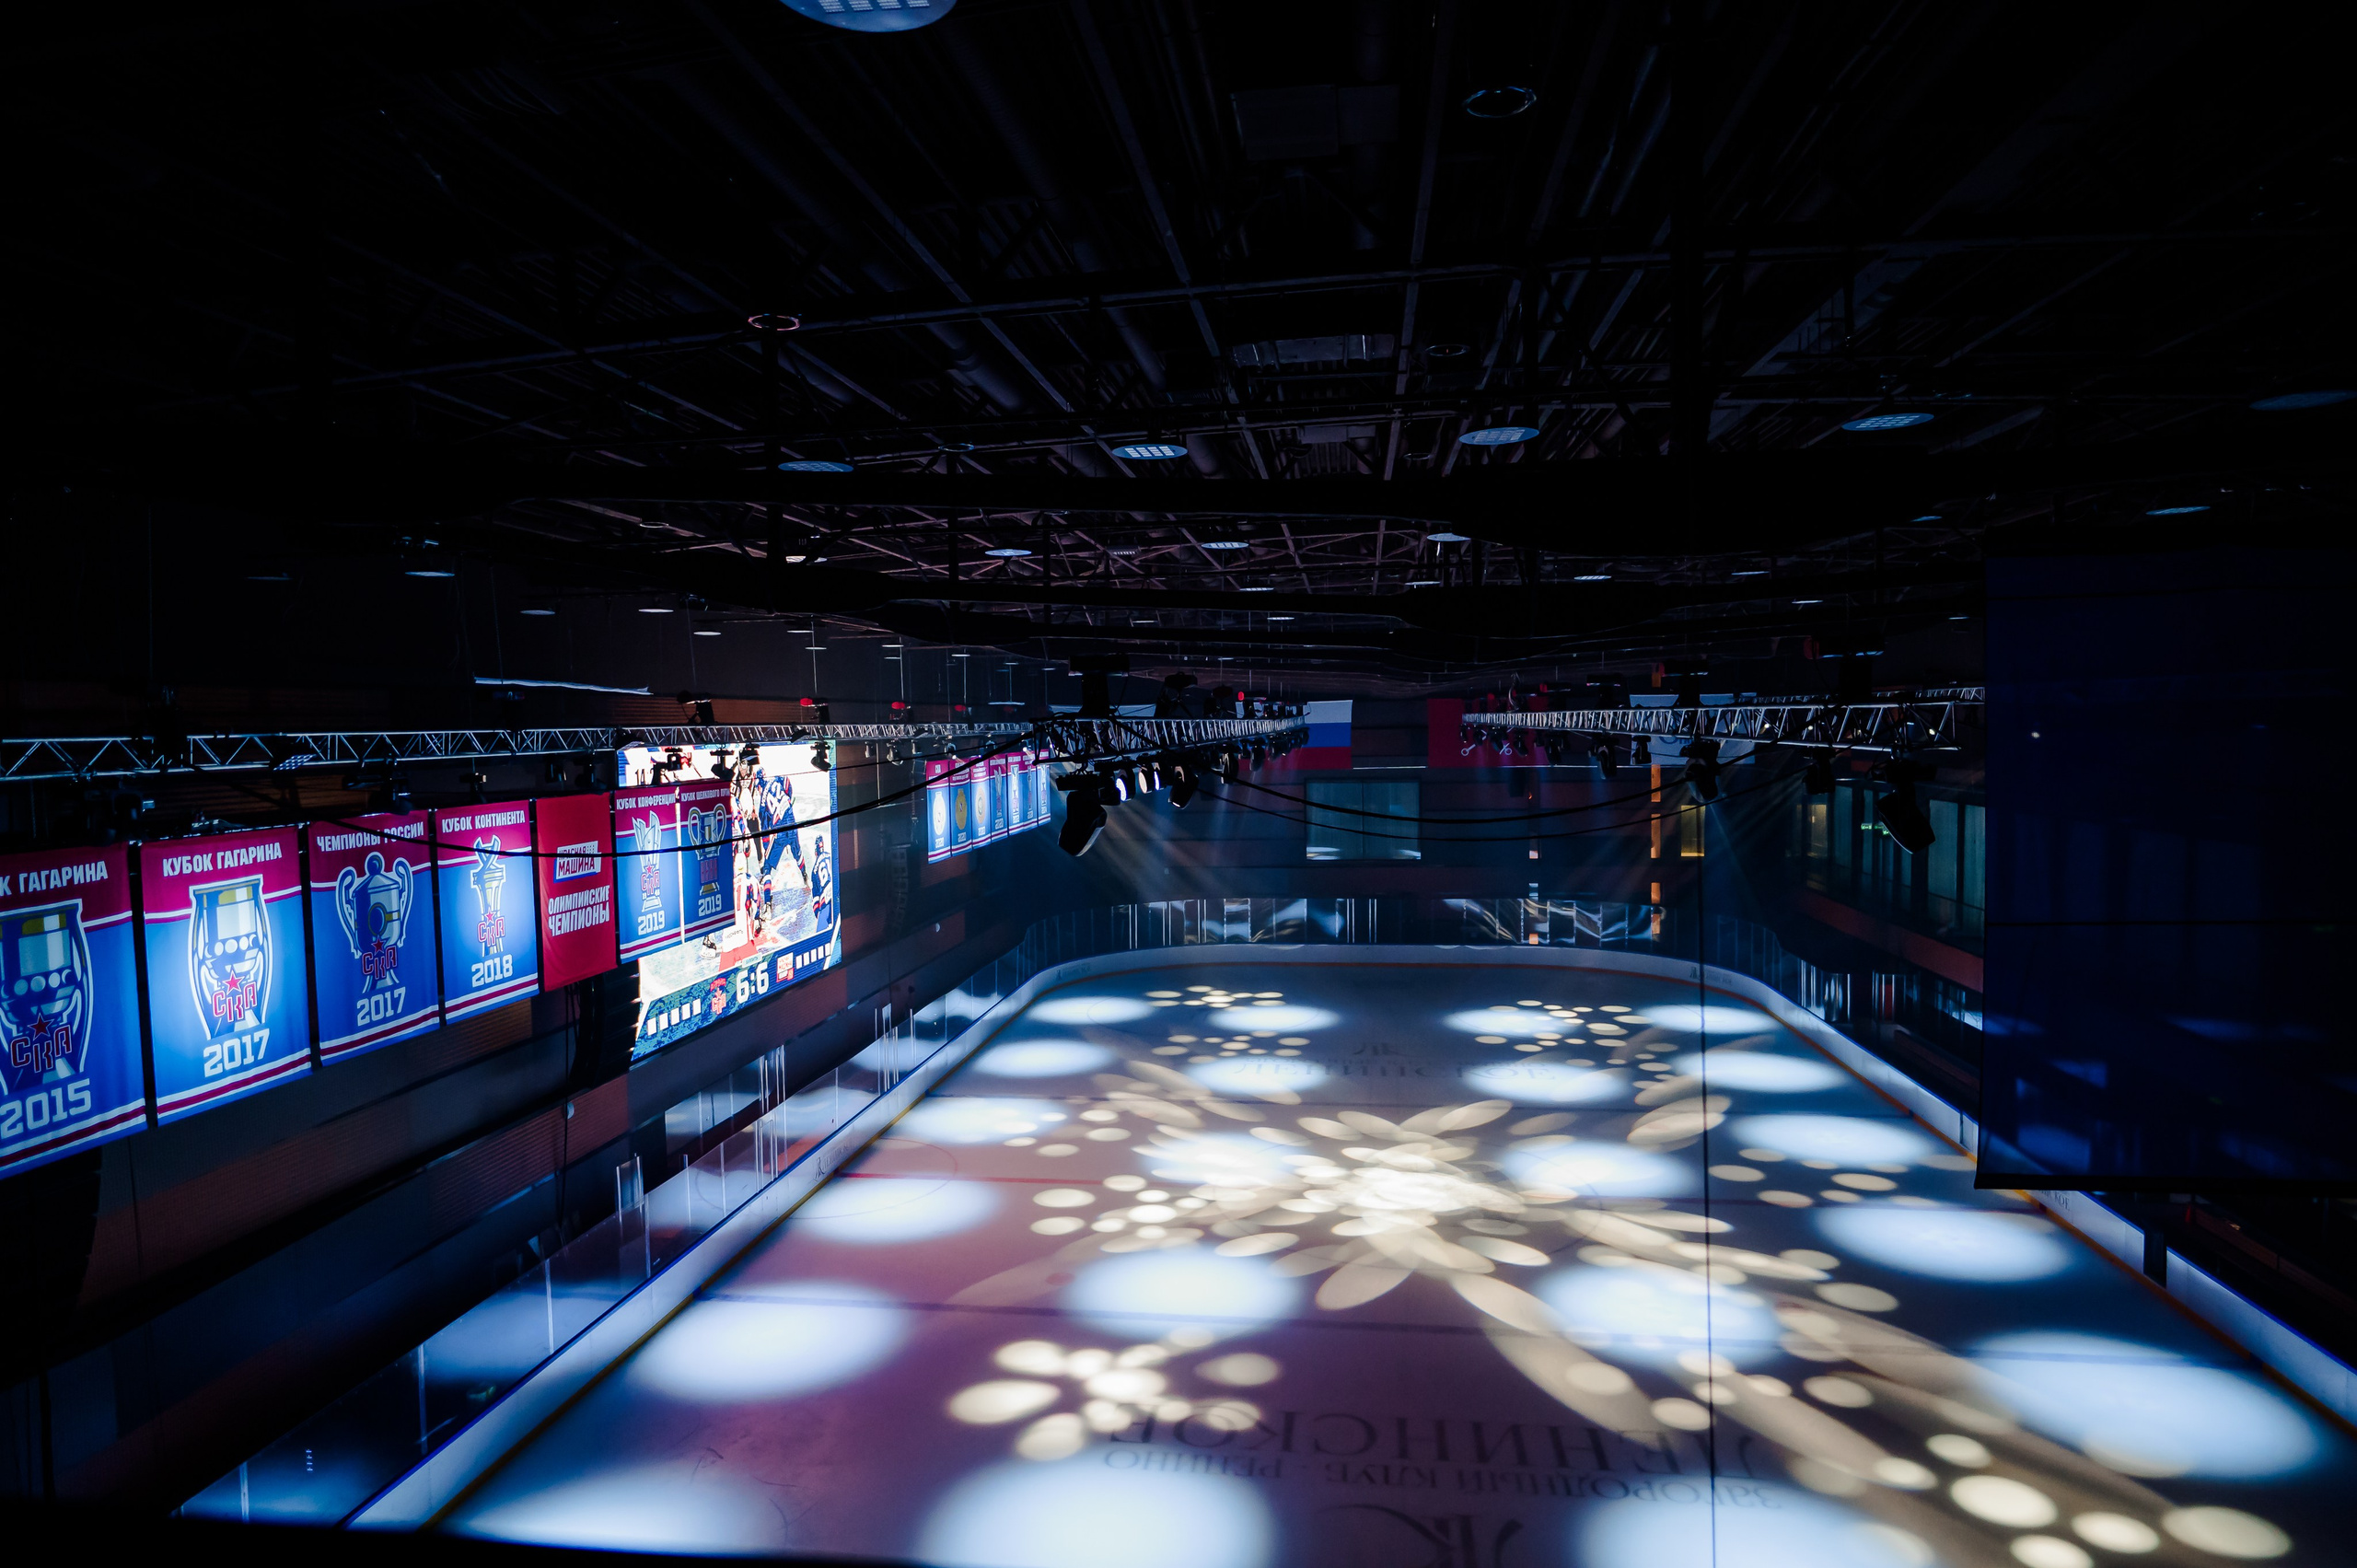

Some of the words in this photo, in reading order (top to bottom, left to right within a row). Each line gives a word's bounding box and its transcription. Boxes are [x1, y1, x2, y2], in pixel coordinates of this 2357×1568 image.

[616, 798, 637, 810] КУБОК
[638, 793, 676, 807] КОНФЕРЕНЦИИ
[317, 829, 381, 852] ЧЕМПИОНЫ
[383, 822, 424, 845] РОССИИ
[442, 817, 472, 833] КУБОК
[474, 810, 526, 830] КОНТИНЕНТА
[162, 849, 214, 877] КУБОК
[216, 842, 283, 870] ГАГАРИНА
[557, 855, 596, 877] МАШИНА
[18, 861, 109, 894] ГАГАРИНА
[548, 885, 610, 915] ОЛИМПИЙСКИЕ
[698, 894, 722, 917] 2019
[478, 917, 505, 947] СКА
[548, 901, 610, 936] ЧЕМПИОНЫ
[637, 910, 666, 936] 2019
[361, 945, 399, 981] СКА
[470, 954, 513, 988] 2018
[737, 961, 770, 1004] 6:6
[213, 981, 259, 1023] СКА
[356, 986, 407, 1028] 2017
[10, 1024, 73, 1074] СКА
[203, 1028, 271, 1078] 2017
[0, 1078, 92, 1139] 2015
[1324, 1462, 1439, 1489] КЛУБ
